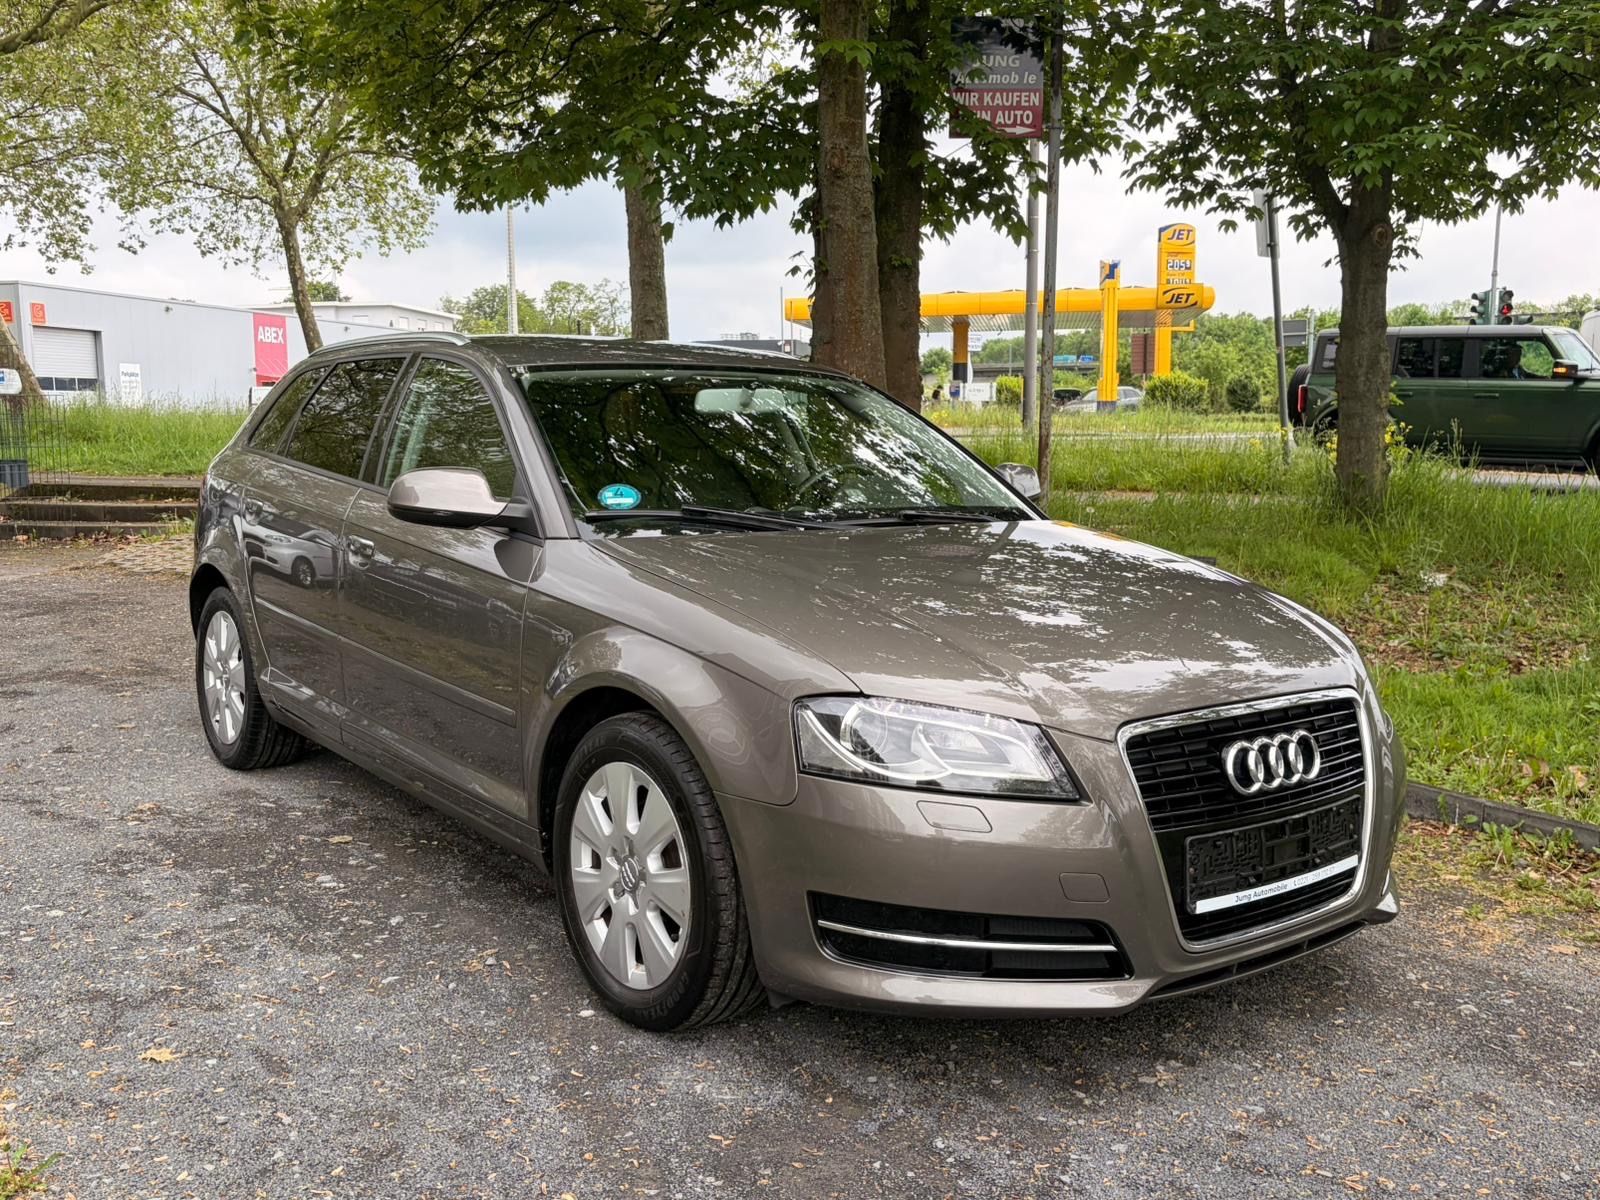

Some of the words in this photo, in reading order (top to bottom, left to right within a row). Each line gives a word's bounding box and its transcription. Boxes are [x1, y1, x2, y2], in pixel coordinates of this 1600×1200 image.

[952, 92, 979, 106] WIR
[984, 92, 1039, 106] KAUFEN
[995, 110, 1033, 125] AUTO
[1167, 229, 1193, 241] JET
[1166, 293, 1194, 304] JET
[257, 325, 285, 344] ABEX
[1235, 893, 1252, 903] Jung
[1253, 882, 1288, 898] Automobile
